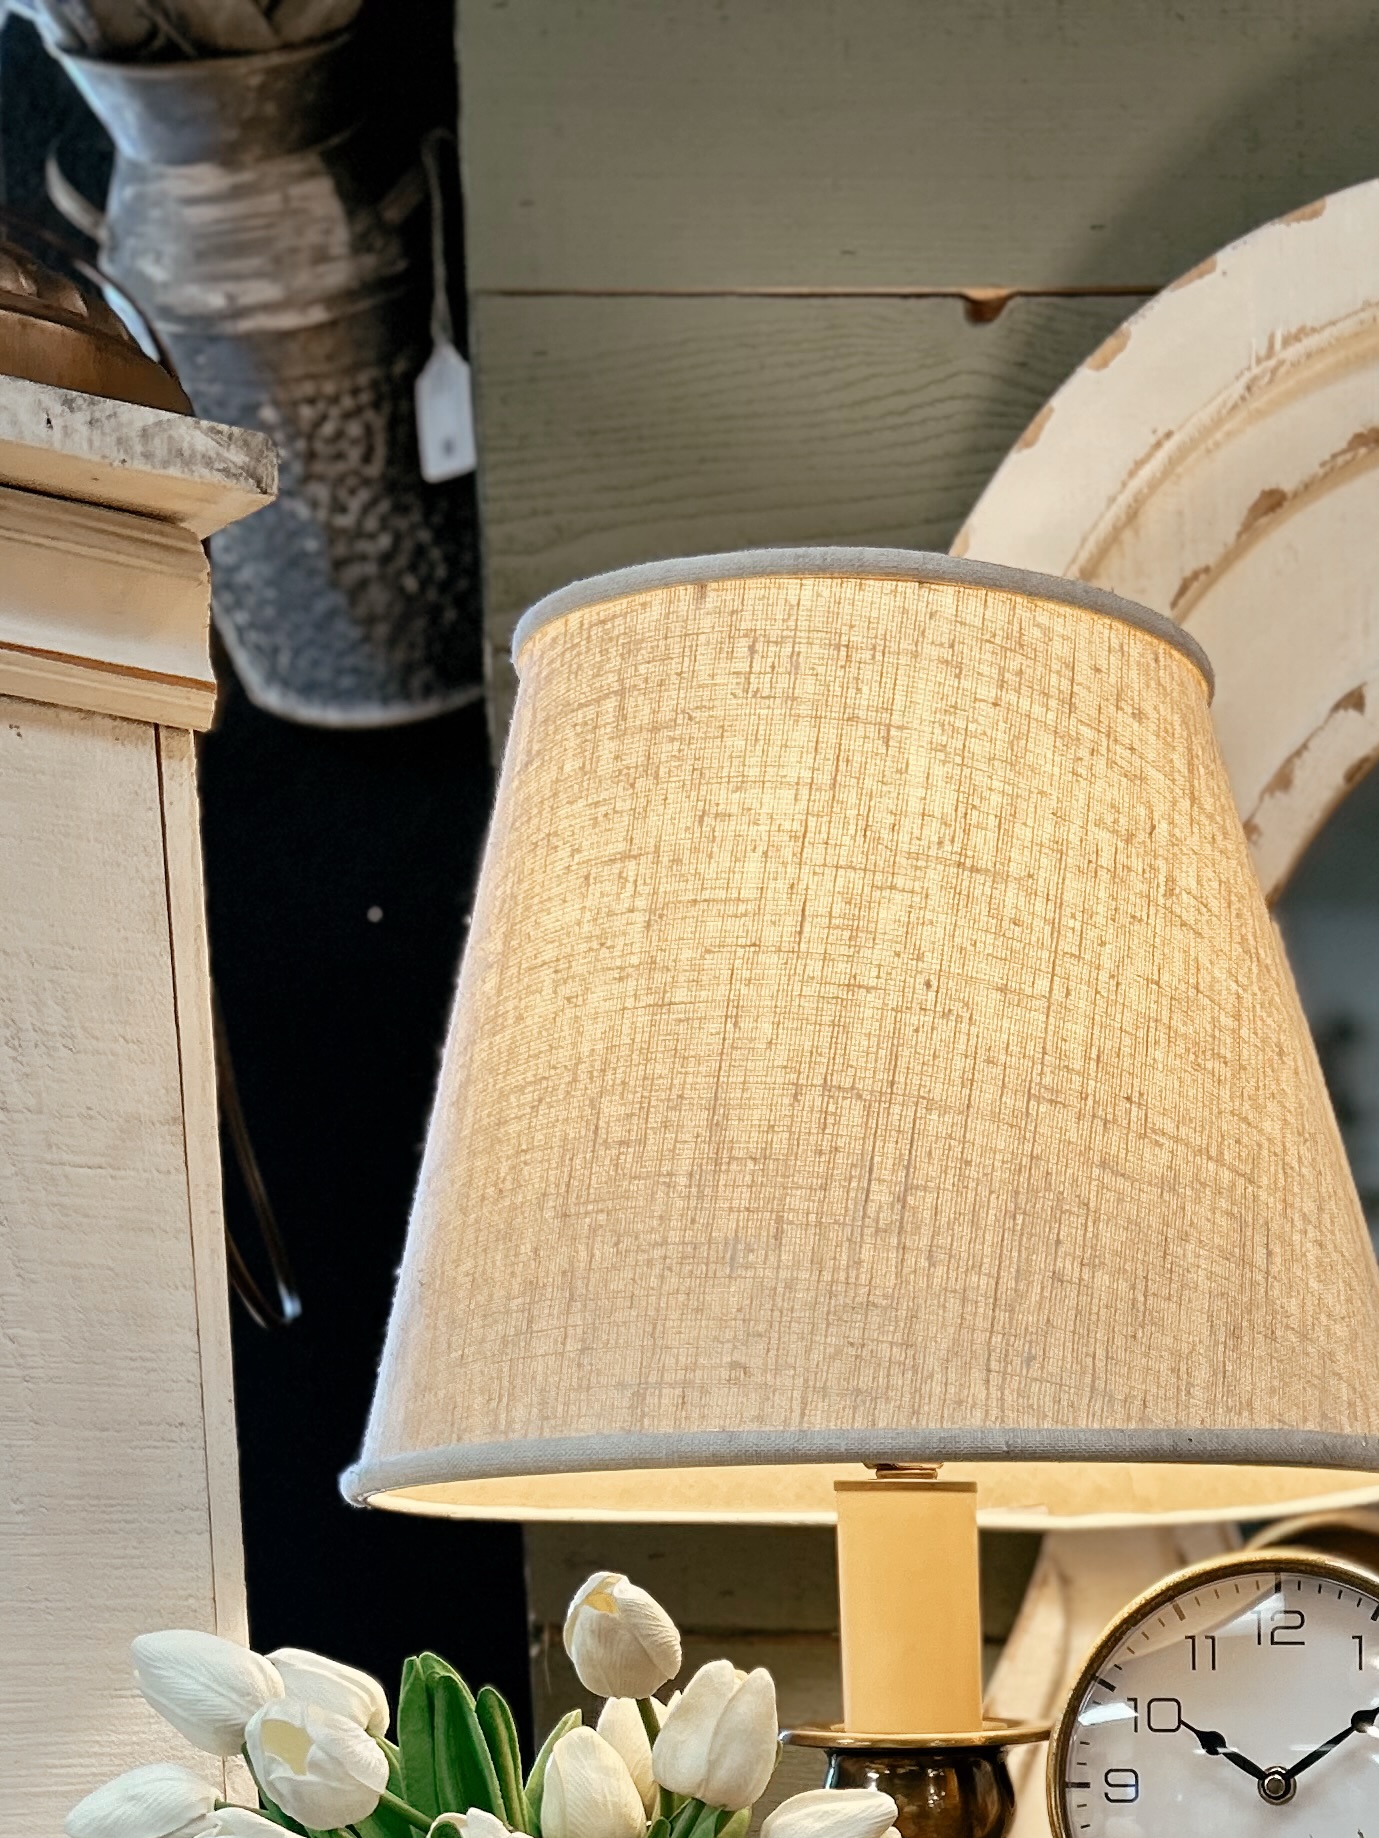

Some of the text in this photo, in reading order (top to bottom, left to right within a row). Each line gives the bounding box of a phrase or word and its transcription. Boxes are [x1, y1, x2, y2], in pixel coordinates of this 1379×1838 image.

[1251, 1609, 1306, 1646] 12
[1184, 1634, 1217, 1671] 11
[1351, 1634, 1363, 1671] 1
[1126, 1696, 1182, 1733] 10
[1103, 1768, 1140, 1804] 9
